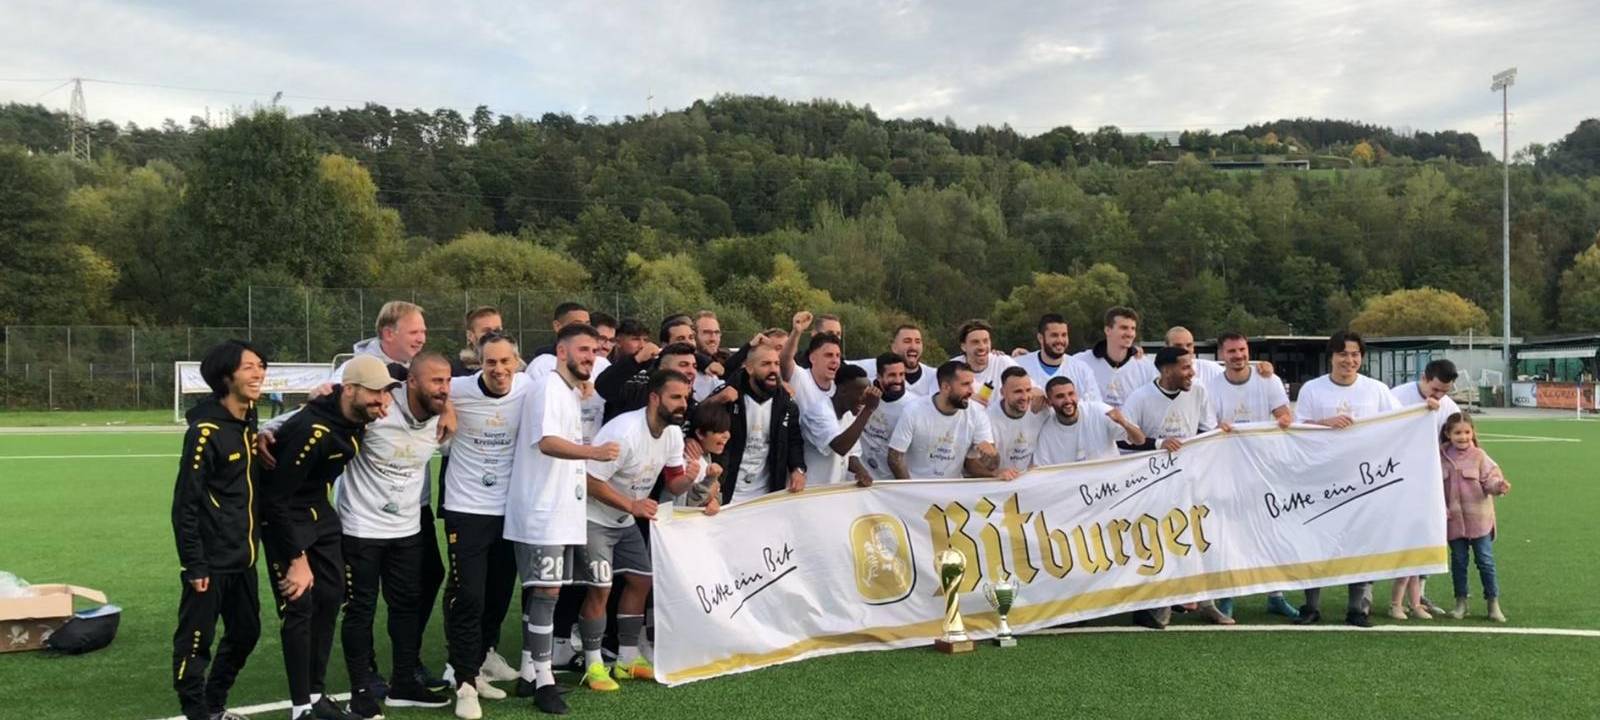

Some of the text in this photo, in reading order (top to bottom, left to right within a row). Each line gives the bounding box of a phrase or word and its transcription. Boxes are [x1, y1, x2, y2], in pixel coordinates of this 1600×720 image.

[1079, 452, 1179, 506] Bitte ein Bit
[1263, 456, 1401, 519] Bitte ein Bit
[540, 555, 565, 580] 28
[589, 560, 612, 583] 10
[923, 491, 1212, 598] Bitburger
[695, 542, 795, 614] Bitte ein Bit
